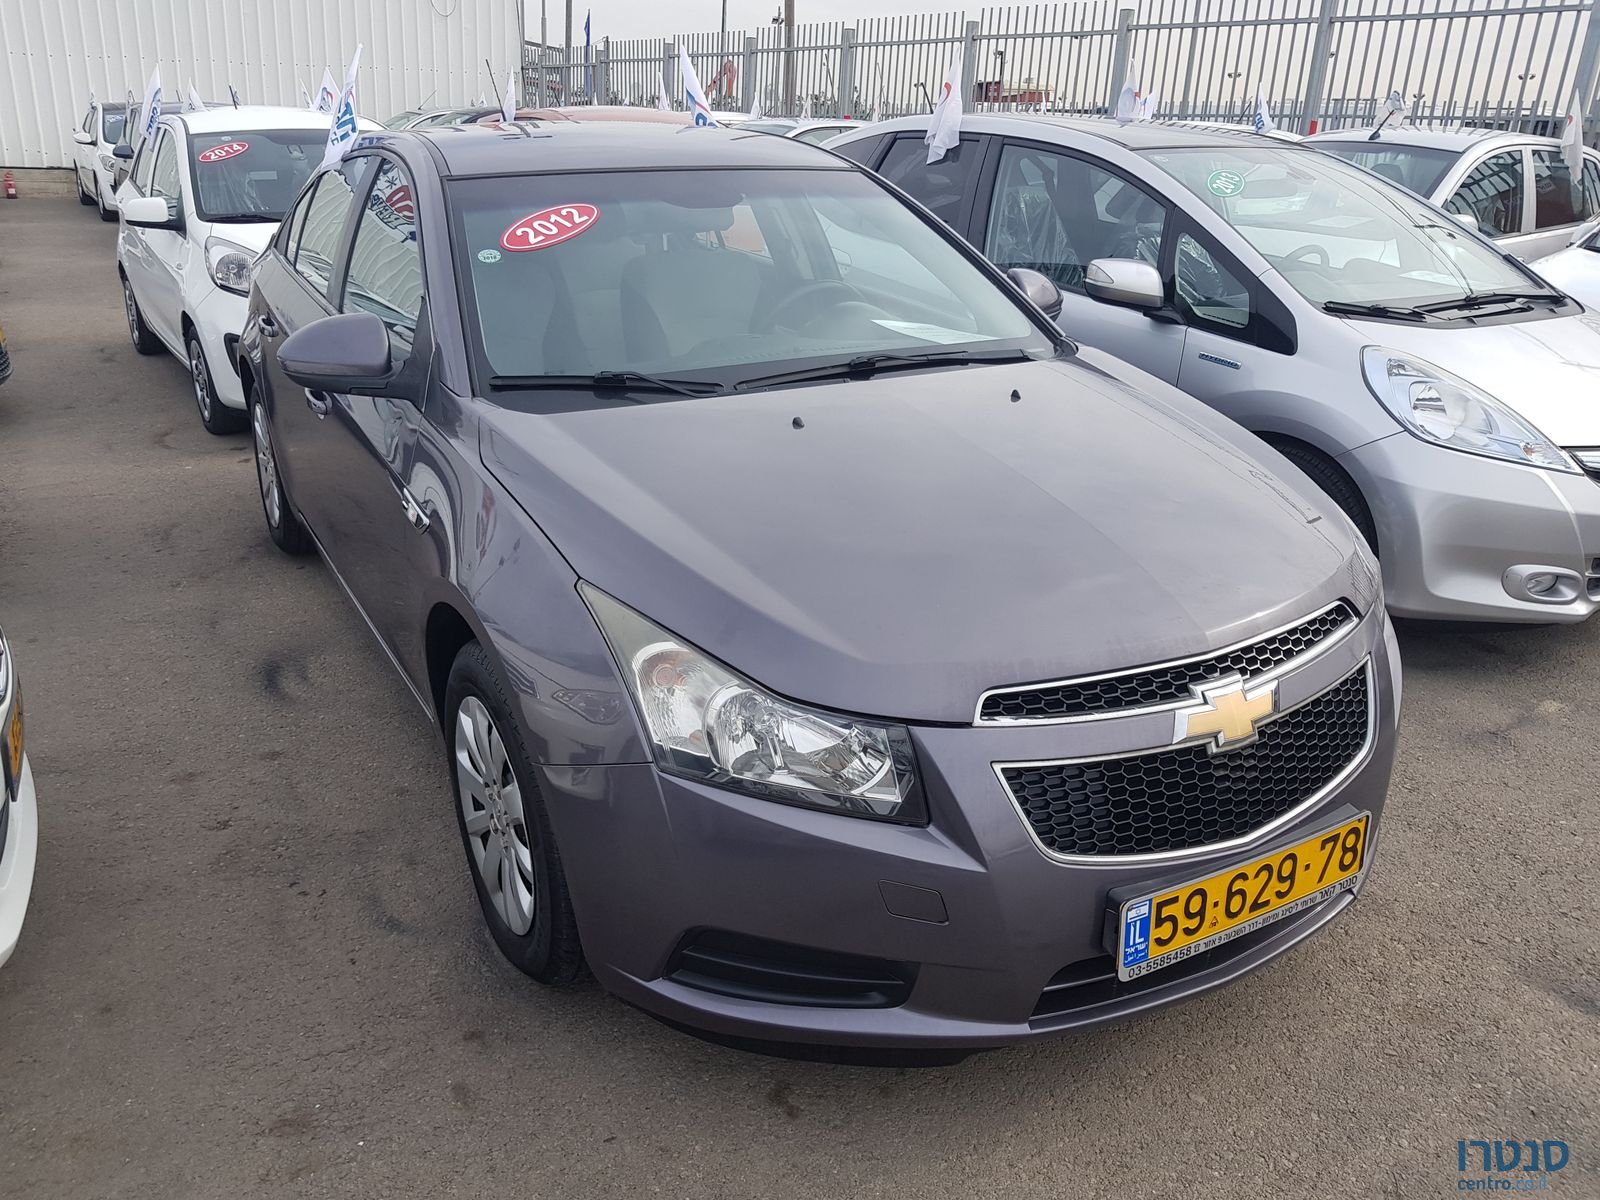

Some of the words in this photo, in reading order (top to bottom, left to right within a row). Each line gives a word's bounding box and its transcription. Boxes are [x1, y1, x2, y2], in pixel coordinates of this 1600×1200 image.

[206, 143, 243, 160] 2014
[1212, 172, 1240, 193] 2013
[515, 207, 590, 245] 2012
[1339, 875, 1358, 891] סנטר
[1129, 919, 1144, 946] IL
[1125, 942, 1149, 955] ישראל
[1128, 946, 1192, 979] 03-5585458
